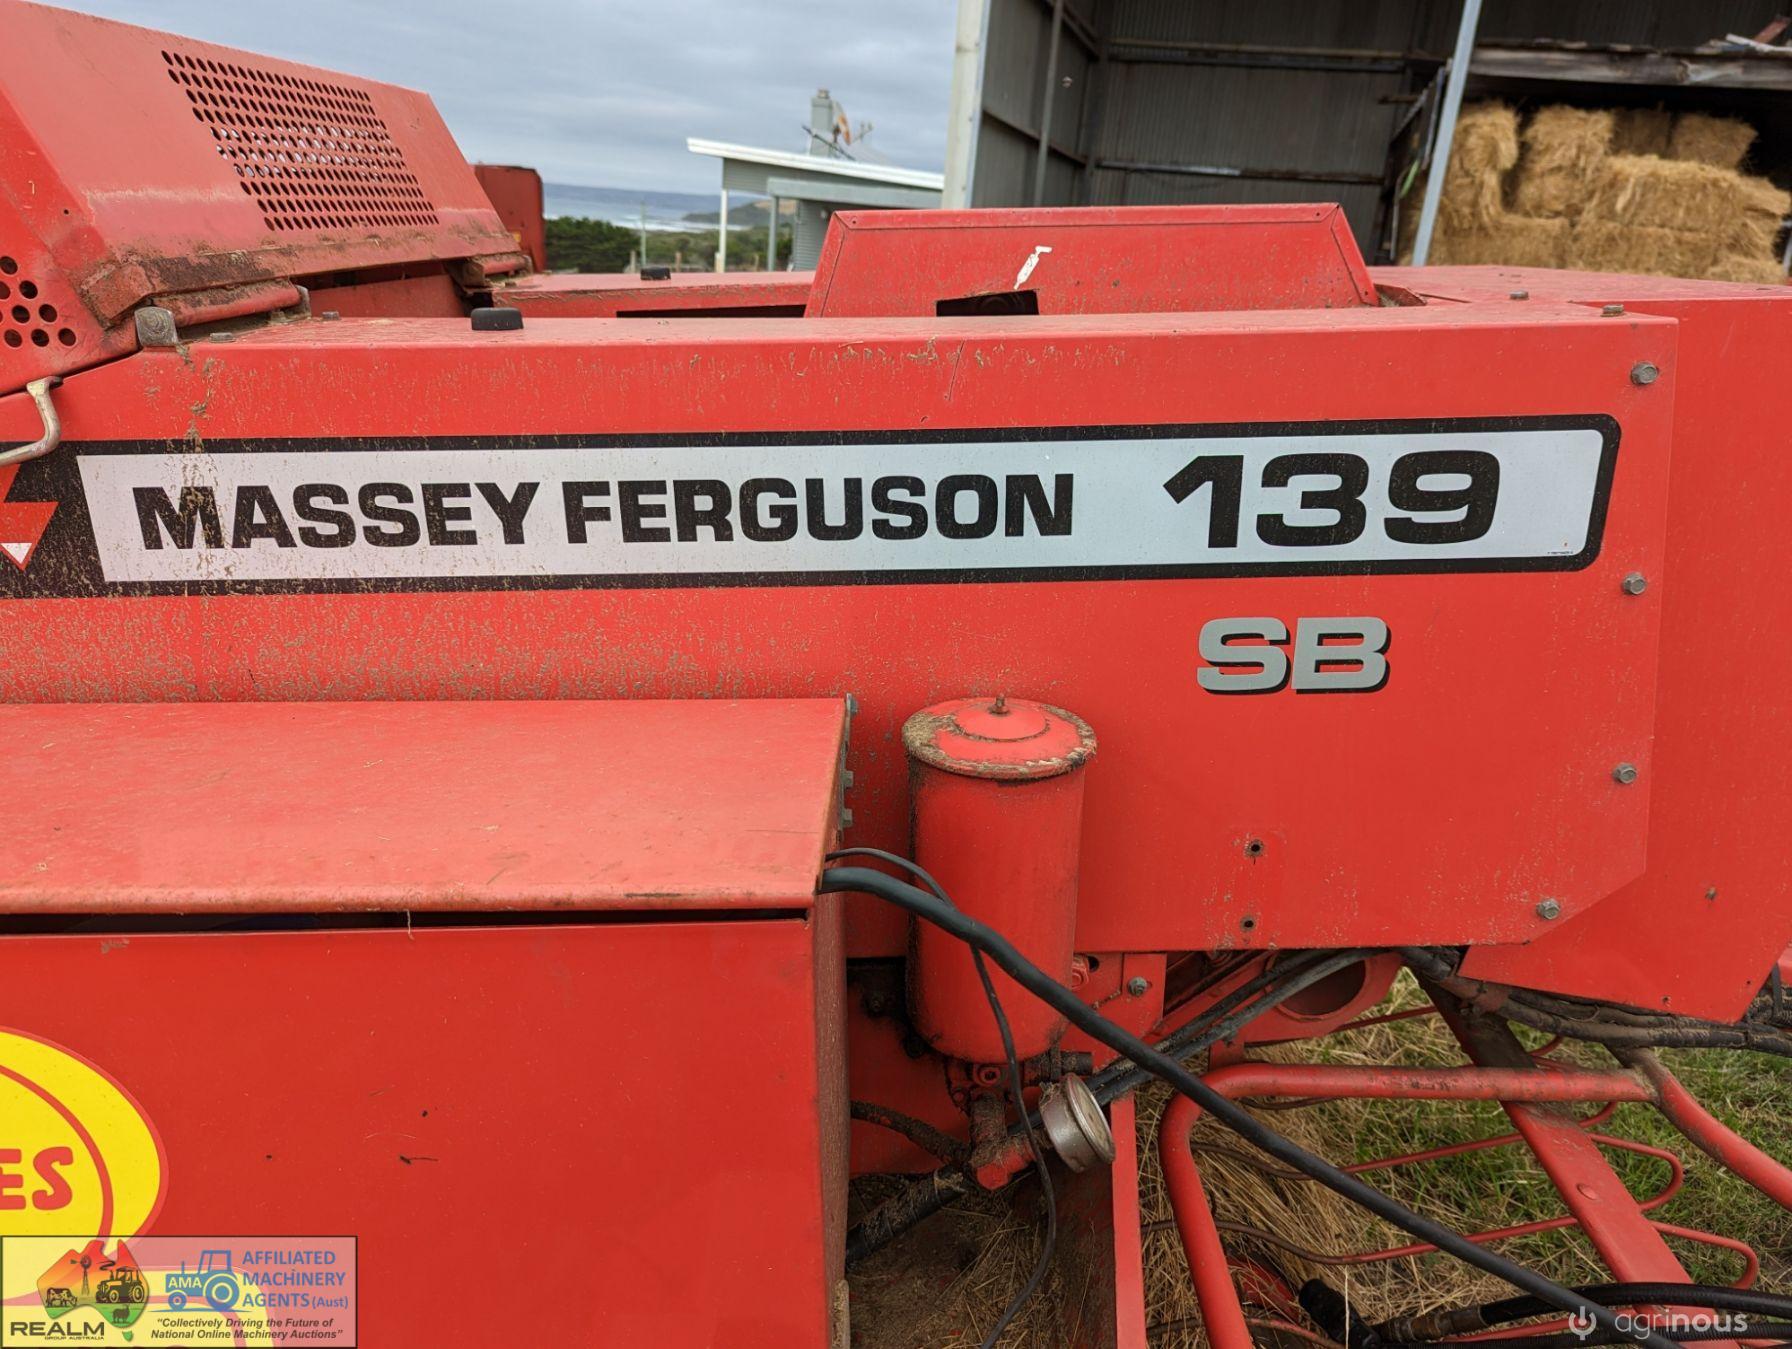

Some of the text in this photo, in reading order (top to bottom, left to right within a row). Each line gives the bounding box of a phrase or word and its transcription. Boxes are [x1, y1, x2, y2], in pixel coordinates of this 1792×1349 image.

[132, 450, 1501, 550] MASSEY FERGUSON 139
[1196, 616, 1391, 694] SB
